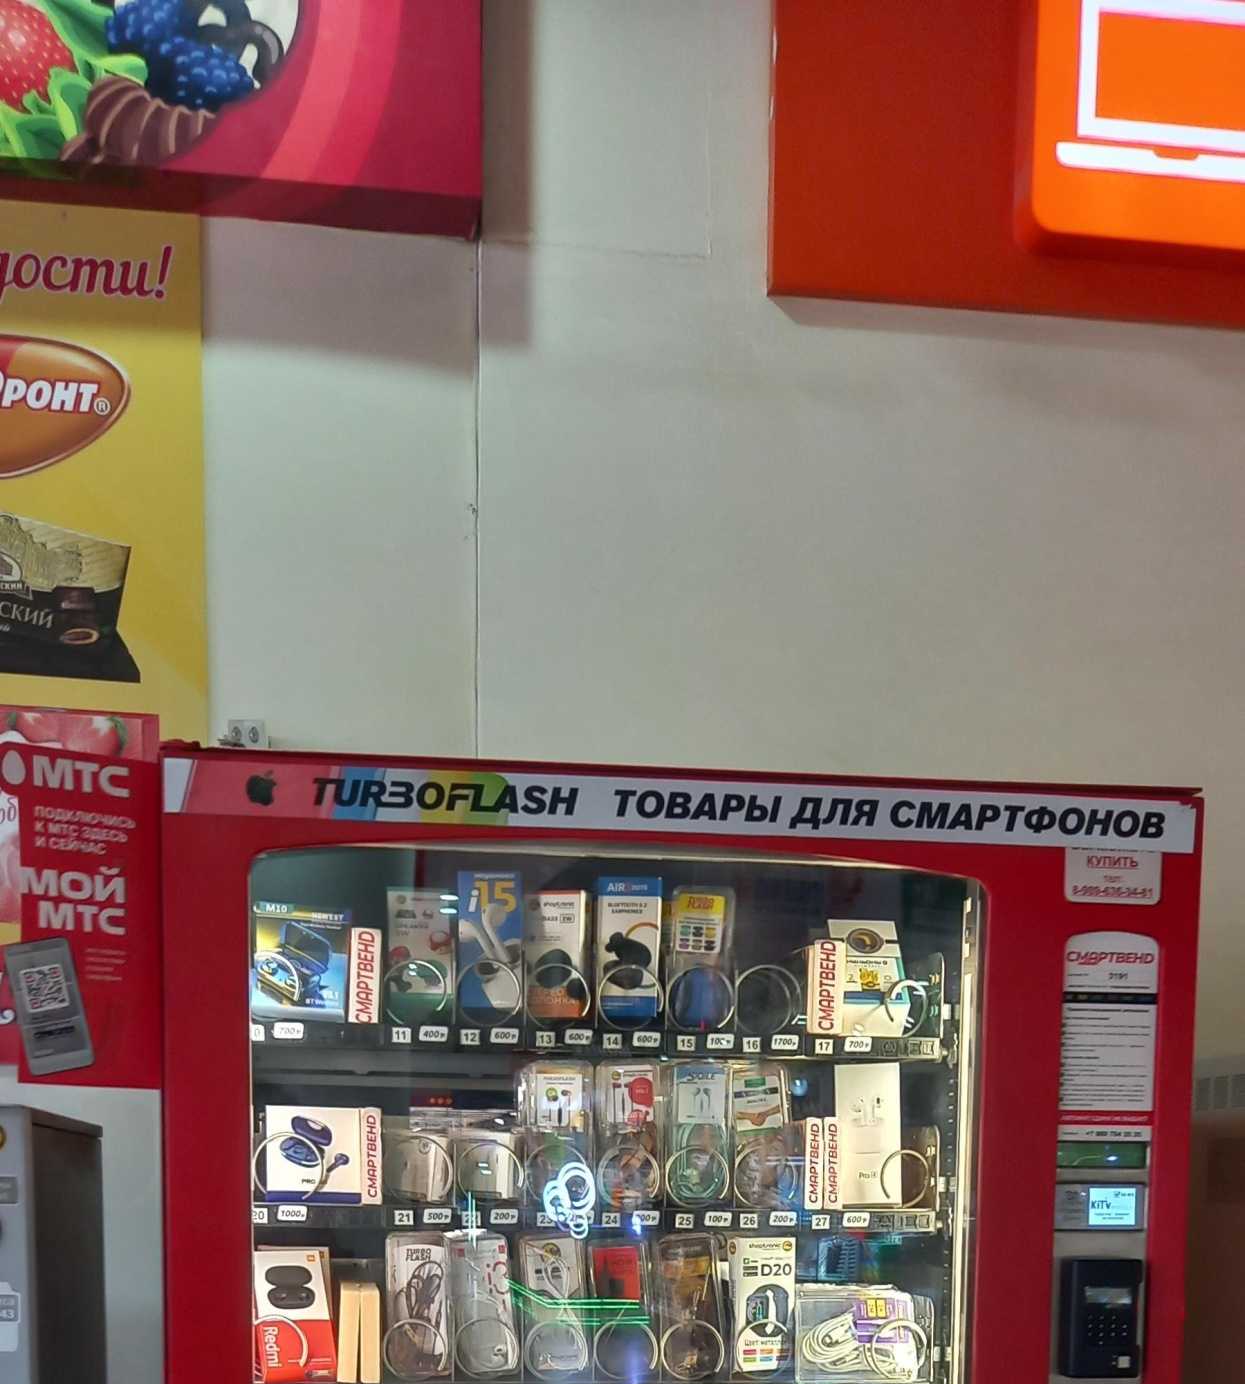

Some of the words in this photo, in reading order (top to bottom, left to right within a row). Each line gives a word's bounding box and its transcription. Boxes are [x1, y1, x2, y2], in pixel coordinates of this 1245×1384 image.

[0, 375, 98, 413] РОНТ
[33, 755, 130, 798] МТС
[313, 777, 578, 815] TURBOFLASH
[614, 790, 782, 823] ТОВАРЫ
[790, 796, 878, 828] ДЛЯ
[891, 799, 1165, 839] СМАРТФОНОВ
[48, 823, 79, 836] МТС
[81, 826, 128, 842] ЗДЕСЬ
[1087, 856, 1139, 867] КУПИТЬ
[20, 865, 125, 903] МОЙ
[38, 901, 126, 935] МТС
[395, 1030, 407, 1040] 11
[464, 1032, 477, 1042] 12
[539, 1034, 552, 1044] 13
[606, 1036, 619, 1046] 14
[680, 1038, 693, 1048] 15
[746, 1040, 758, 1050] 16
[818, 1042, 830, 1051] 17
[400, 1213, 410, 1222] 21
[605, 1215, 617, 1224] 24
[678, 1215, 691, 1225] 25
[742, 1216, 755, 1225] 26
[815, 1217, 827, 1226] 27
[761, 1264, 792, 1276] D20
[263, 1326, 282, 1368] Redmi
